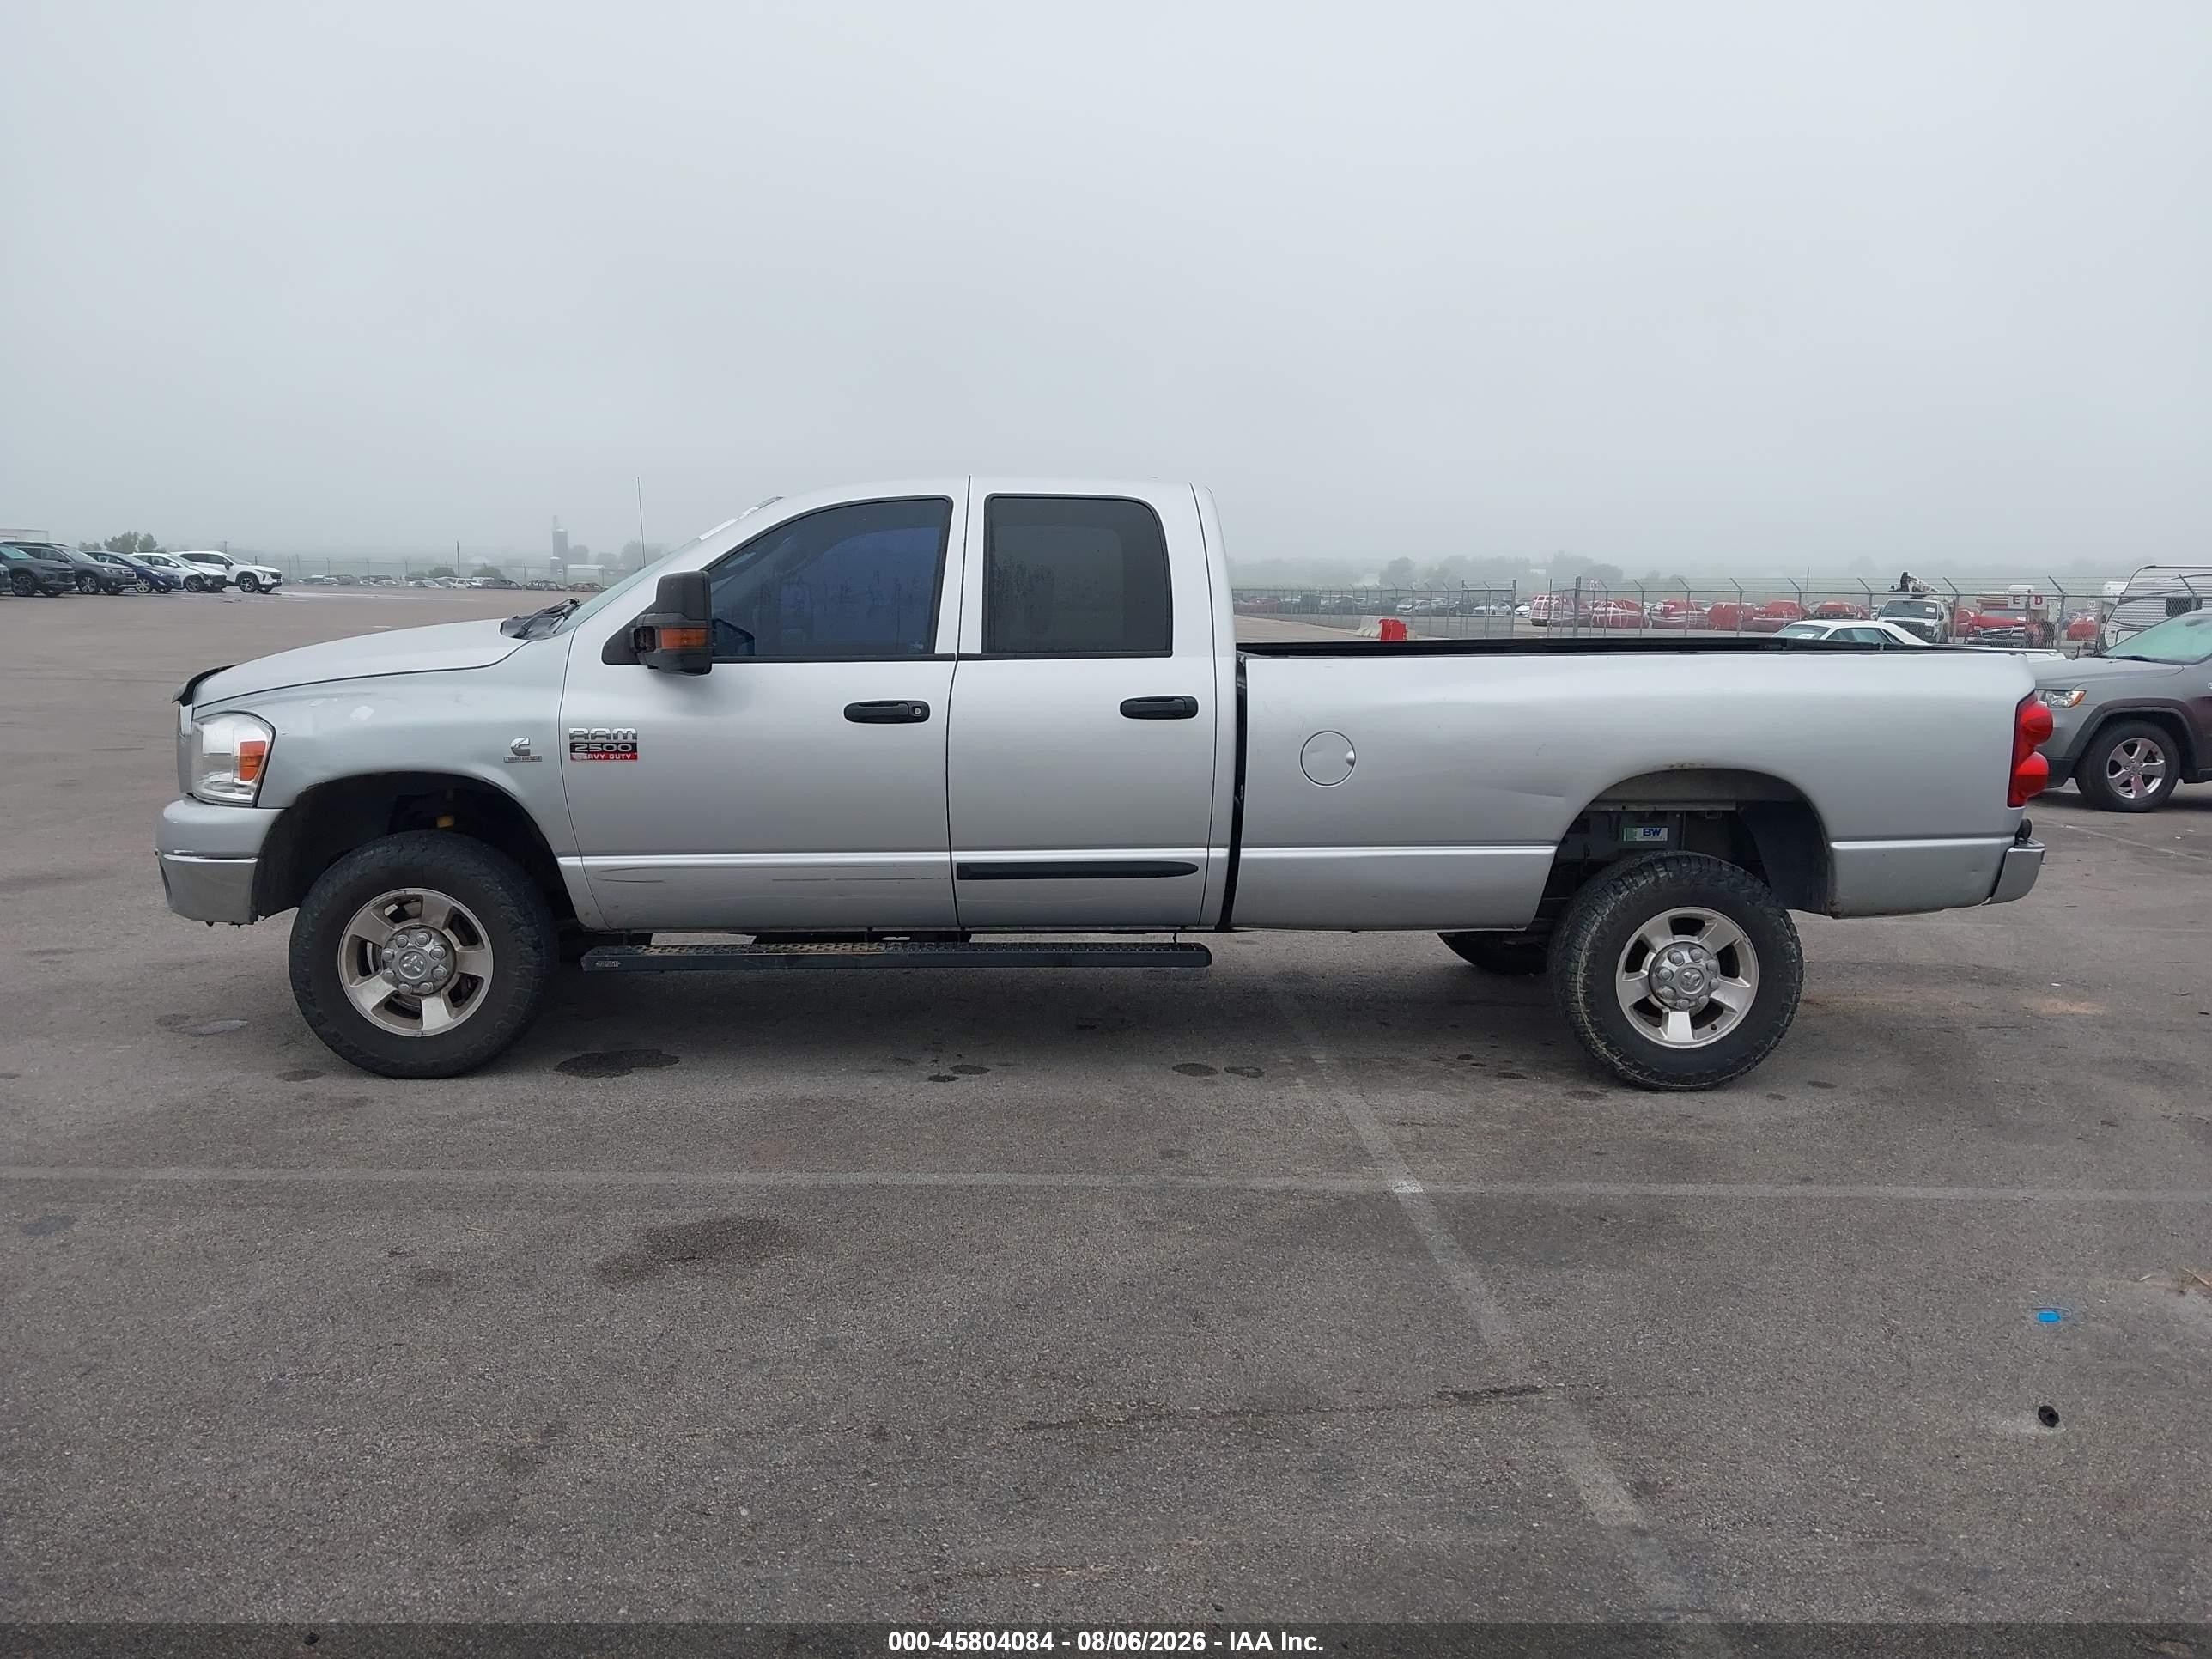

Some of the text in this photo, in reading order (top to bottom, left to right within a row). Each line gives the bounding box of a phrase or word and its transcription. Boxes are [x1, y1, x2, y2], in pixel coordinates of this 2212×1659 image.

[2033, 595, 2043, 605] D
[568, 727, 638, 741] RAM
[574, 743, 633, 752] 2500
